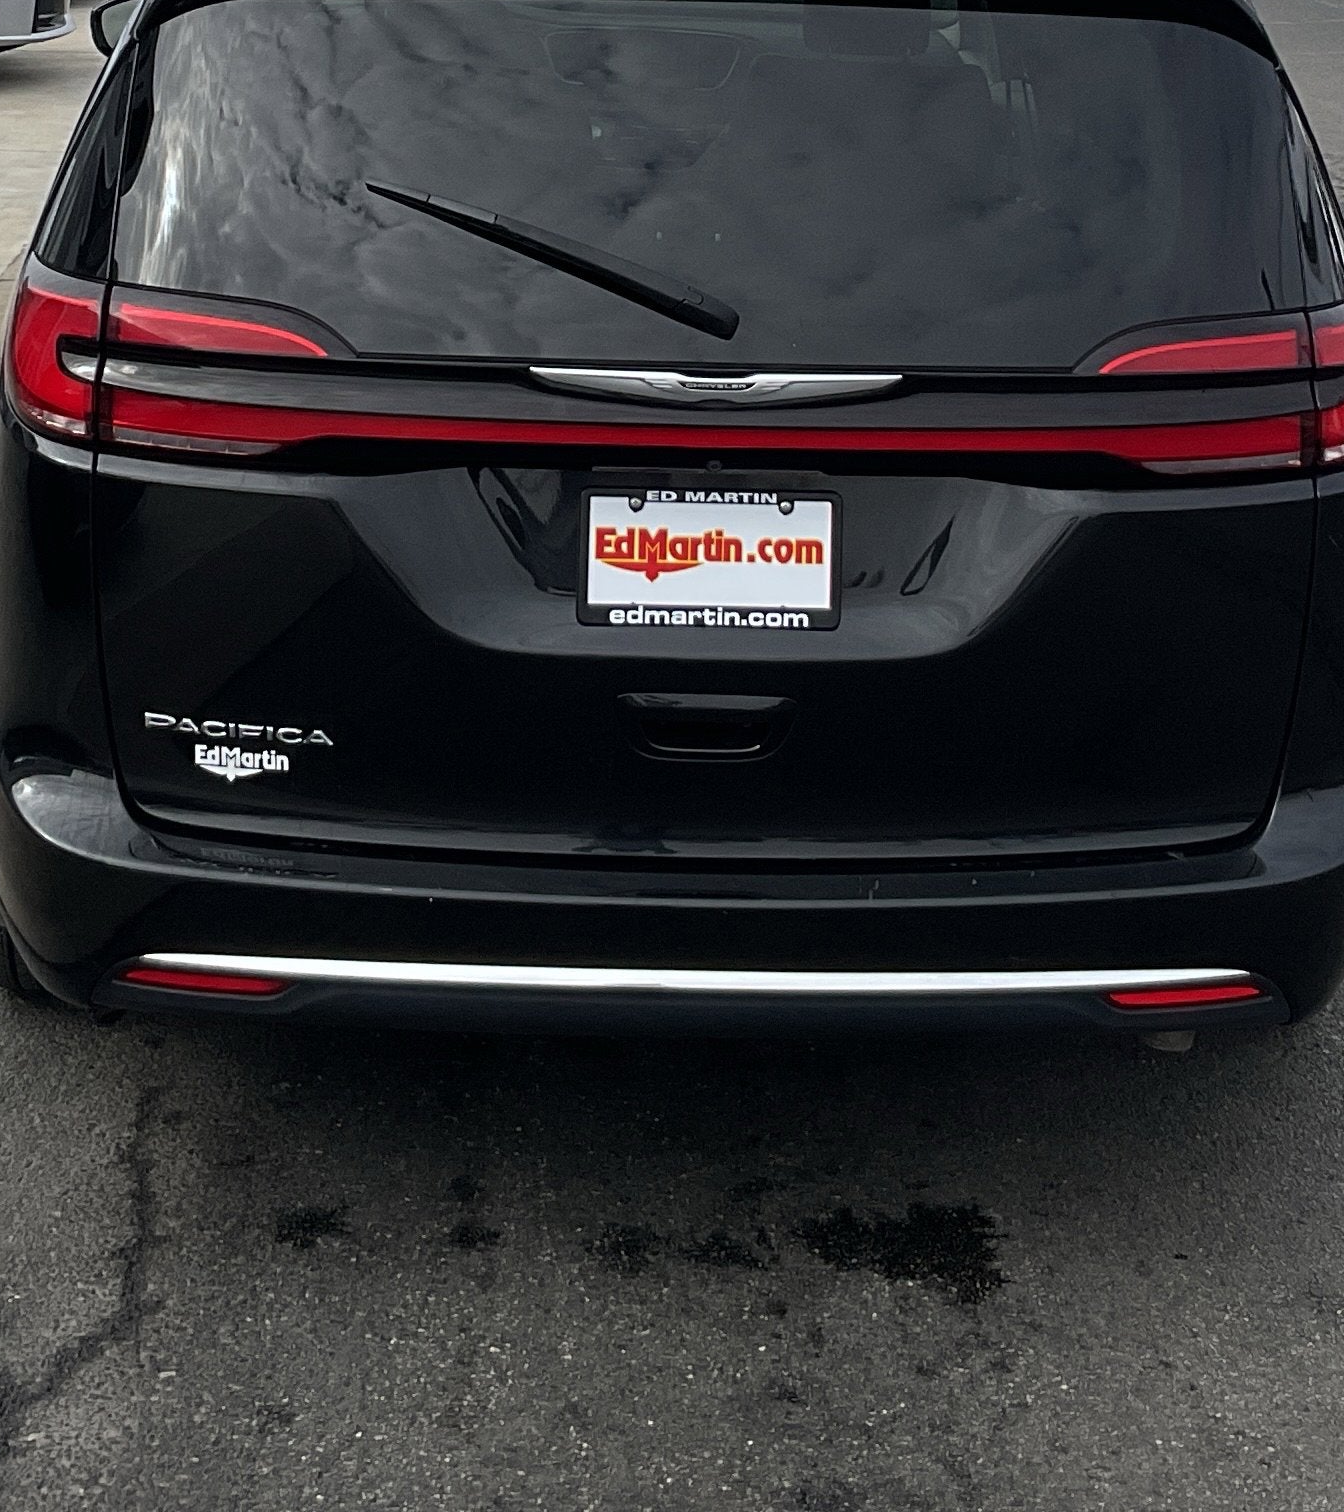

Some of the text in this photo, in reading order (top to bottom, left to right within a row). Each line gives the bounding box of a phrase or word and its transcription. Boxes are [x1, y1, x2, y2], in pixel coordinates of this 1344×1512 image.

[646, 490, 778, 504] ED MARTIN
[595, 526, 824, 568] EdMartin.com
[609, 605, 810, 628] edmartin.com
[143, 711, 335, 746] PACIFICA
[194, 743, 290, 772] EdMartin
